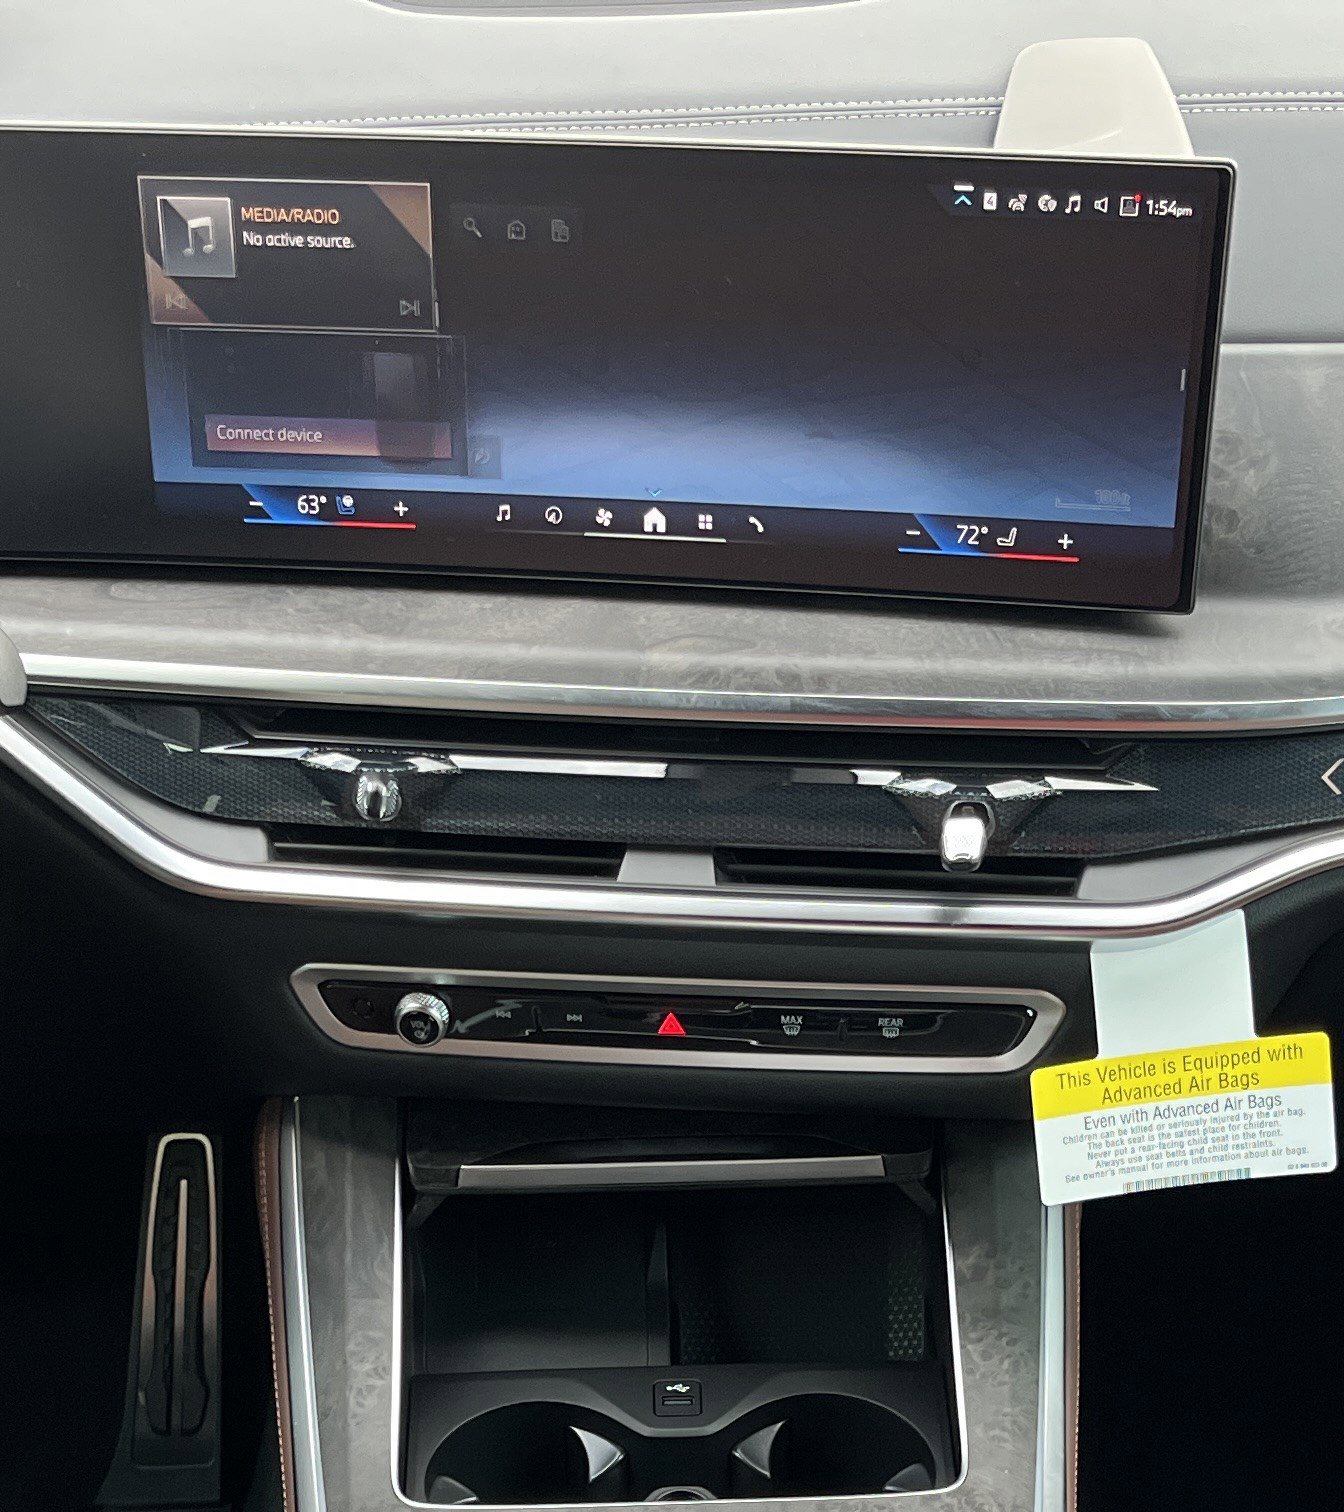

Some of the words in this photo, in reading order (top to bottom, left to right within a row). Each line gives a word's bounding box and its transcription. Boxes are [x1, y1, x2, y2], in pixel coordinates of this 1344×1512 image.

[241, 206, 341, 225] MEDIA/RADIO
[1145, 199, 1193, 218] 1:54pm
[242, 231, 262, 246] No
[266, 232, 305, 248] active
[307, 235, 356, 249] source.
[216, 424, 275, 442] Connect
[277, 427, 324, 443] device
[956, 525, 989, 545] 72°
[780, 1015, 803, 1025] MAX
[878, 1017, 903, 1027] REAR
[1056, 1071, 1091, 1090] This
[1096, 1061, 1157, 1083] Vehicle
[1162, 1057, 1176, 1074] is
[1182, 1045, 1261, 1073] Equipped
[1267, 1042, 1304, 1062] with
[1101, 1078, 1182, 1105] Advanced
[1188, 1075, 1212, 1093] Air
[1219, 1070, 1260, 1090] Bags
[1062, 1132, 1098, 1146] Children
[1100, 1130, 1115, 1140] can
[1117, 1127, 1128, 1137] be
[1130, 1123, 1154, 1134] killed
[1156, 1122, 1166, 1132] or
[1168, 1115, 1207, 1130] seriously
[1210, 1112, 1241, 1125] injured
[1243, 1111, 1255, 1122] by
[1256, 1110, 1271, 1119] the
[1273, 1108, 1285, 1117] air
[1287, 1107, 1306, 1118] bag.
[1083, 1115, 1116, 1131] Even
[1119, 1108, 1149, 1125] with
[1152, 1098, 1219, 1121] Advanced
[1224, 1097, 1244, 1112] Air
[1248, 1094, 1282, 1110] Bags
[1086, 1141, 1103, 1151] The
[1105, 1137, 1125, 1148] back
[1127, 1134, 1146, 1145] seat
[1147, 1132, 1156, 1142] is
[1157, 1130, 1172, 1140] the
[1174, 1126, 1200, 1138] safest
[1202, 1124, 1226, 1136] place
[1228, 1122, 1241, 1132] for
[1087, 1150, 1112, 1160] Never
[1114, 1146, 1128, 1158] put
[1130, 1146, 1136, 1154] a
[1138, 1139, 1185, 1153] rear-facing
[1187, 1135, 1208, 1147] child
[1211, 1133, 1229, 1143] seat
[1231, 1132, 1240, 1141] in
[1242, 1130, 1257, 1140] the
[1259, 1128, 1283, 1138] front.
[1064, 1173, 1081, 1184] See
[1083, 1168, 1116, 1180] owner's
[1118, 1163, 1149, 1175] manual
[1151, 1160, 1164, 1171] for
[1166, 1157, 1189, 1168] more
[1191, 1150, 1242, 1166] information
[1243, 1147, 1270, 1160] about
[1271, 1146, 1284, 1157] air
[1285, 1144, 1309, 1156] bags.
[1095, 1156, 1125, 1169] Always
[1128, 1154, 1143, 1164] use
[1145, 1151, 1164, 1162] seat
[1166, 1148, 1187, 1159] belts
[1188, 1145, 1205, 1156] and
[1207, 1143, 1229, 1154] child
[1231, 1140, 1276, 1151] restraints.
